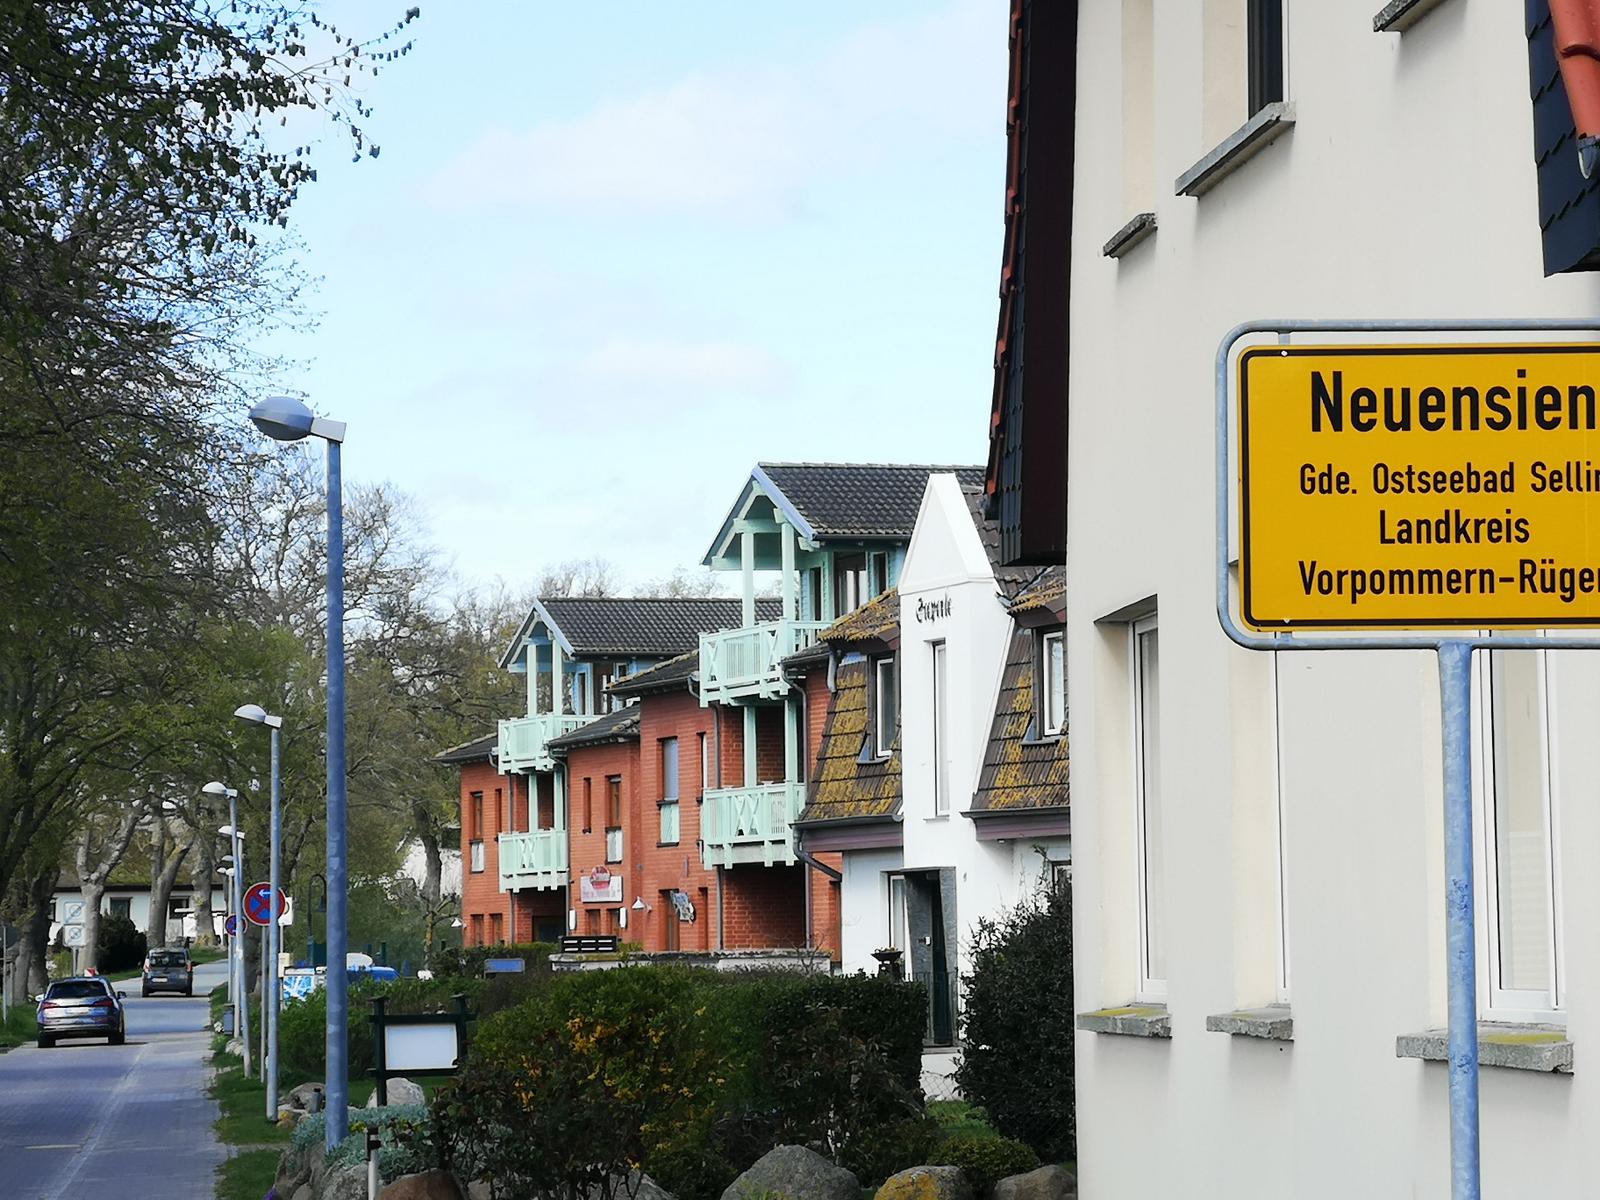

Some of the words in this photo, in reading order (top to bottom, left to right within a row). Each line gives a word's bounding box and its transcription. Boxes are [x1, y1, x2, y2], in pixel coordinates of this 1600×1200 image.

[1311, 369, 1595, 432] Neuensien
[1301, 464, 1356, 494] Gde.
[1374, 462, 1514, 494] Ostseebad
[1380, 509, 1529, 544] Landkreis
[1299, 559, 1600, 604] Vorpommern-Rüge
